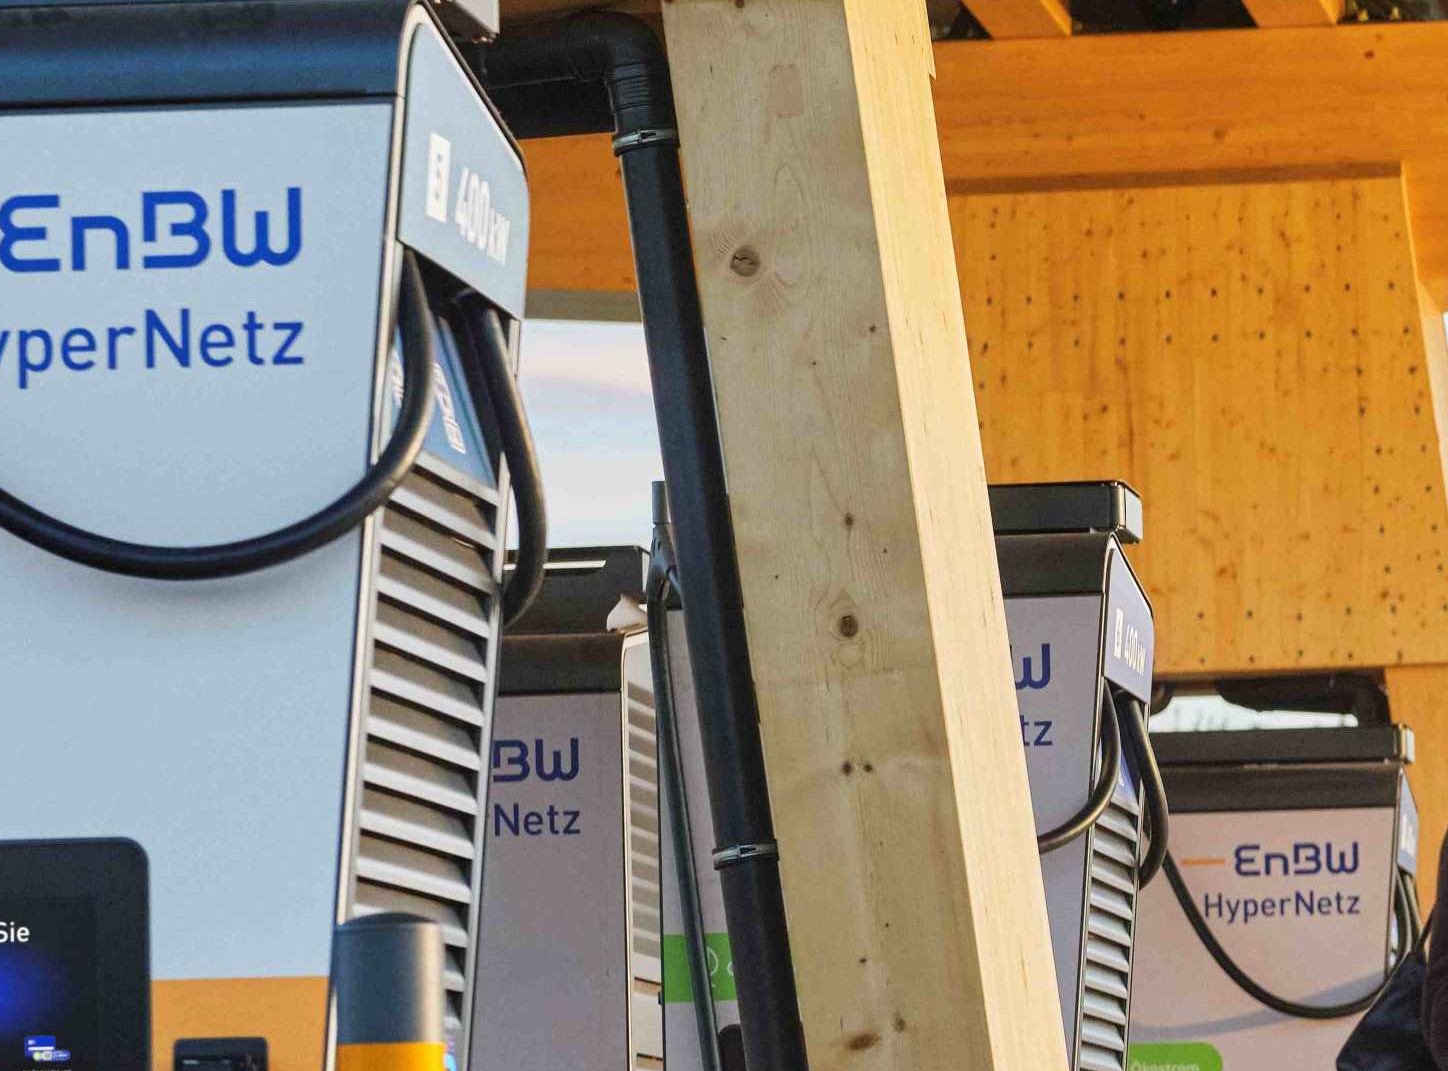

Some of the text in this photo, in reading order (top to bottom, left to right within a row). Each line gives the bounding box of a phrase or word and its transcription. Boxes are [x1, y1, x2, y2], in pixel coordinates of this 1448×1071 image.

[493, 737, 579, 783] BW
[1234, 841, 1359, 876] EnBW
[1204, 890, 1360, 924] HyperNetz
